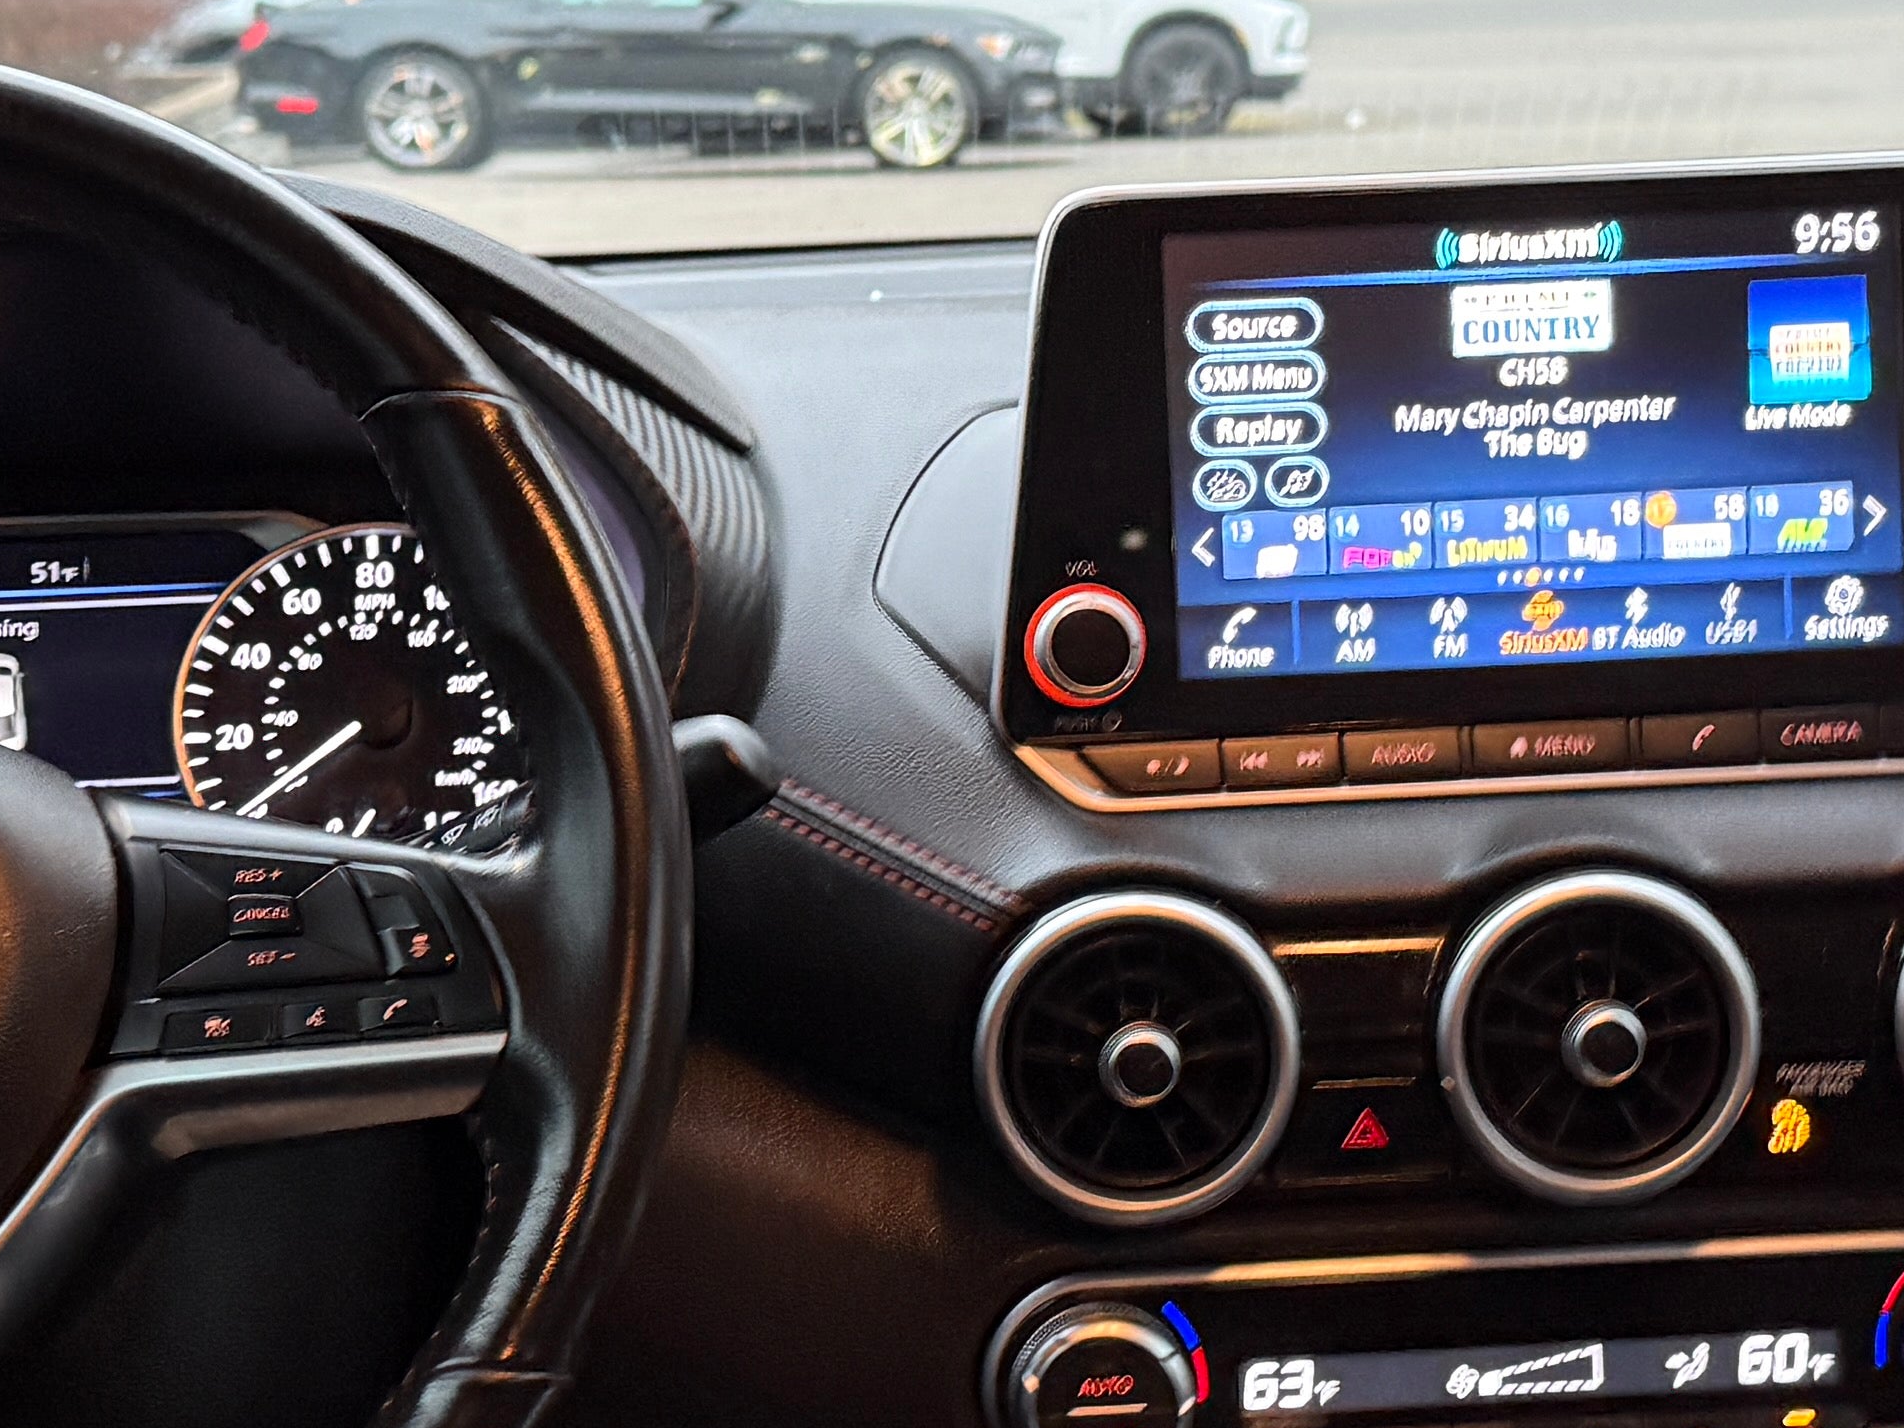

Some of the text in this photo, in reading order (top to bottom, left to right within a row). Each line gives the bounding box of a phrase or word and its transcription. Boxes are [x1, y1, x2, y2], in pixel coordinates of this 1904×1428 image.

[1795, 211, 1879, 254] 9:56
[1212, 313, 1296, 340] Source
[1463, 314, 1600, 346] COUNTRY
[1200, 363, 1312, 392] SXM Menu
[1499, 357, 1568, 387] CH58
[1215, 414, 1301, 447] Replay
[1395, 395, 1676, 438] Mary Chapin Carpenter
[1744, 400, 1853, 431] Live Mode
[1484, 428, 1588, 460] The Bug
[1230, 520, 1254, 542] 13
[1293, 515, 1326, 541] 98
[1400, 509, 1431, 536] 10
[1441, 509, 1465, 533] 15
[1504, 504, 1536, 532] 34
[1546, 504, 1570, 528] 16
[1610, 499, 1640, 527] 18
[1714, 494, 1745, 521] 58
[1819, 489, 1849, 516] 36
[355, 560, 395, 588] 80
[282, 588, 322, 615] 60
[230, 642, 272, 671] 40
[1208, 645, 1274, 670] Phone
[1336, 638, 1376, 663] AM
[1433, 634, 1468, 659] FM
[1500, 627, 1589, 656] SiriusXM
[1592, 627, 1619, 652] BT
[1621, 622, 1686, 650] Audio
[1804, 613, 1890, 643] Settings
[214, 723, 254, 751] 20
[1372, 743, 1437, 766] AUDIO
[1077, 1374, 1134, 1398] AUTO
